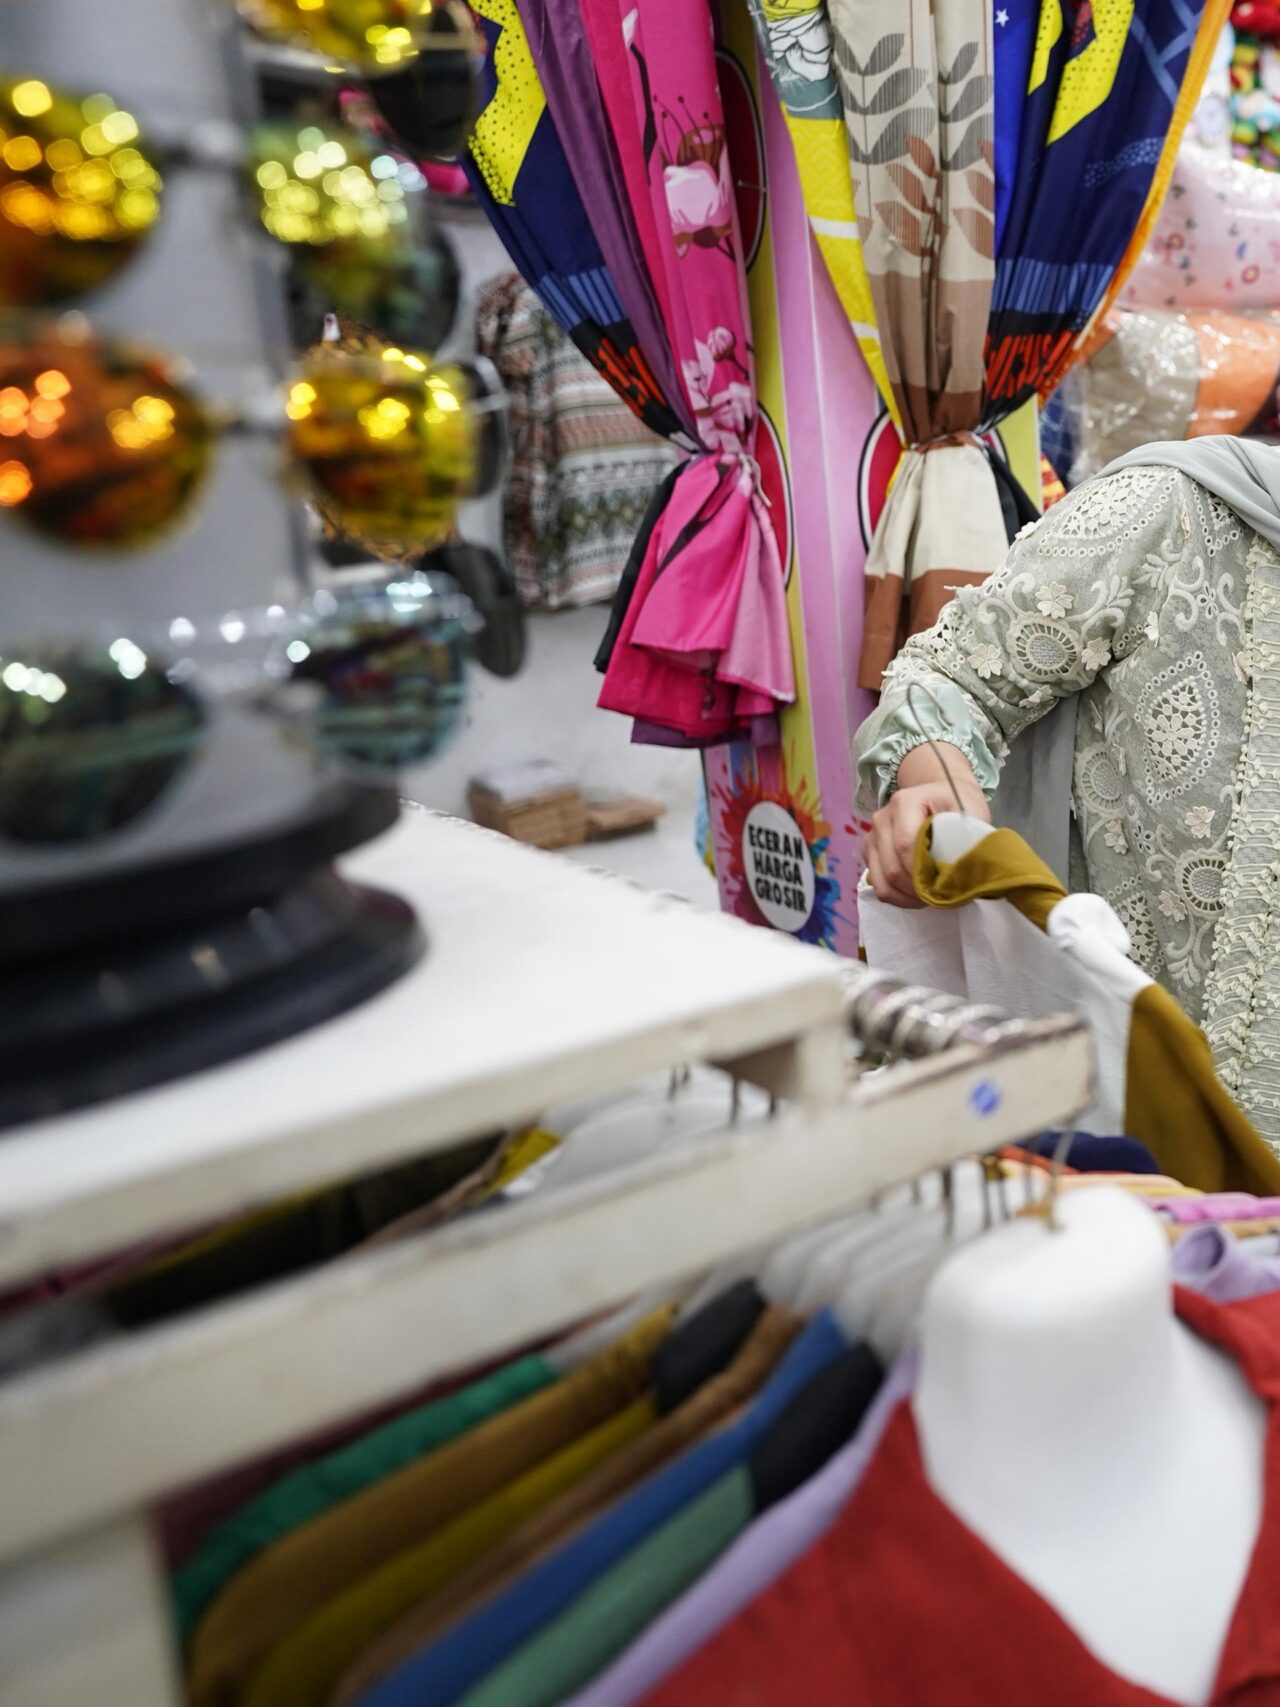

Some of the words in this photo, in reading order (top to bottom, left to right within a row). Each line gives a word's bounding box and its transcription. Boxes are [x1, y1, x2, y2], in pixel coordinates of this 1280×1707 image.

[748, 824, 804, 861] ECERAN
[753, 851, 803, 886] HARGA
[755, 878, 807, 913] GROSIR
